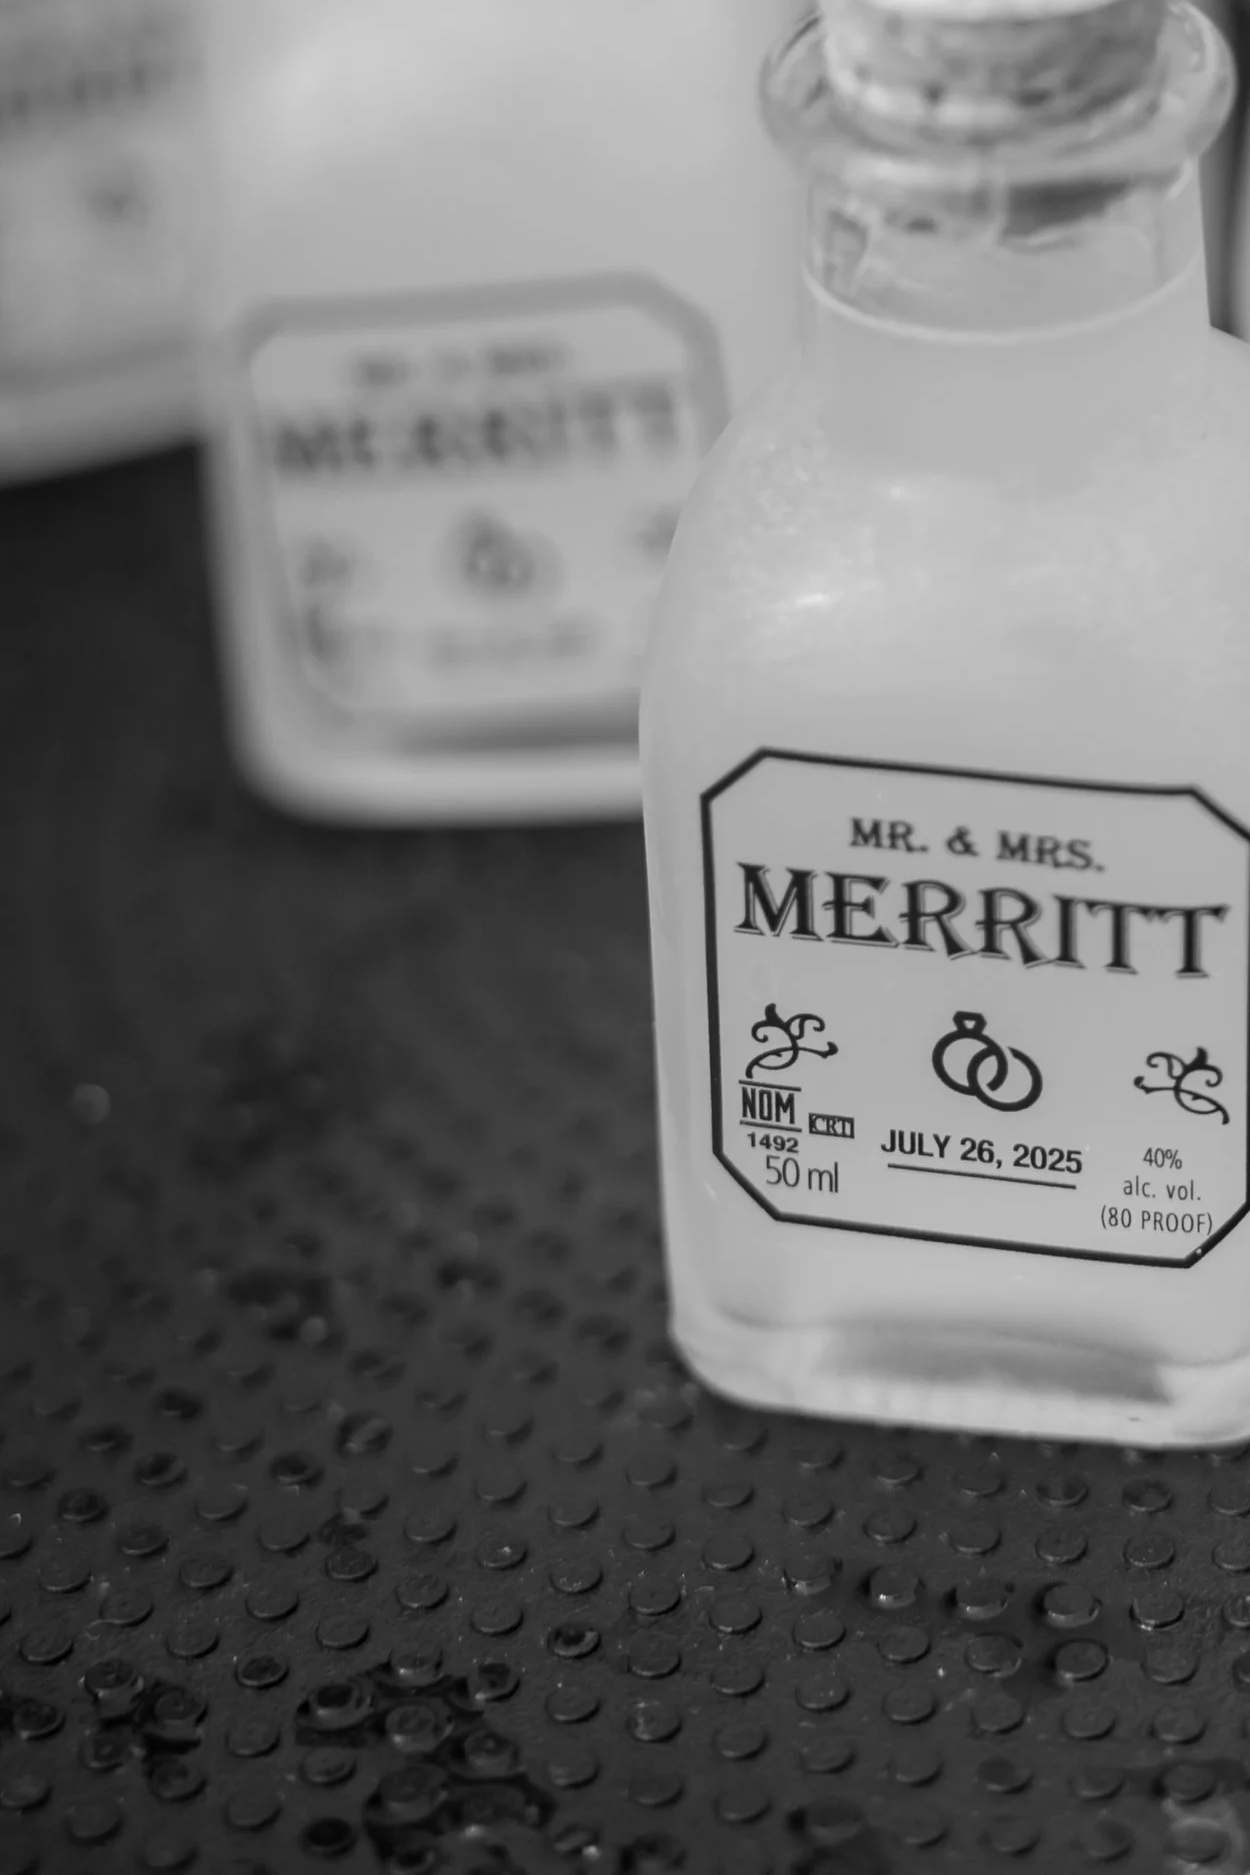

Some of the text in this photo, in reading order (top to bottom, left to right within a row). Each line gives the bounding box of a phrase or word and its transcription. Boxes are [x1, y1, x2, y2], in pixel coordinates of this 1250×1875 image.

[849, 817, 1105, 873] MR. & MRS.
[732, 861, 1229, 979] MERRITT
[741, 1086, 796, 1125] NOM
[747, 1131, 799, 1154] 1492
[880, 1128, 1083, 1174] JULY 26, 2025
[1142, 1146, 1183, 1170] 40%
[765, 1155, 839, 1193] 50 ml
[1122, 1175, 1201, 1201] alc. vol.
[1100, 1205, 1213, 1236] (80 PROOF)
